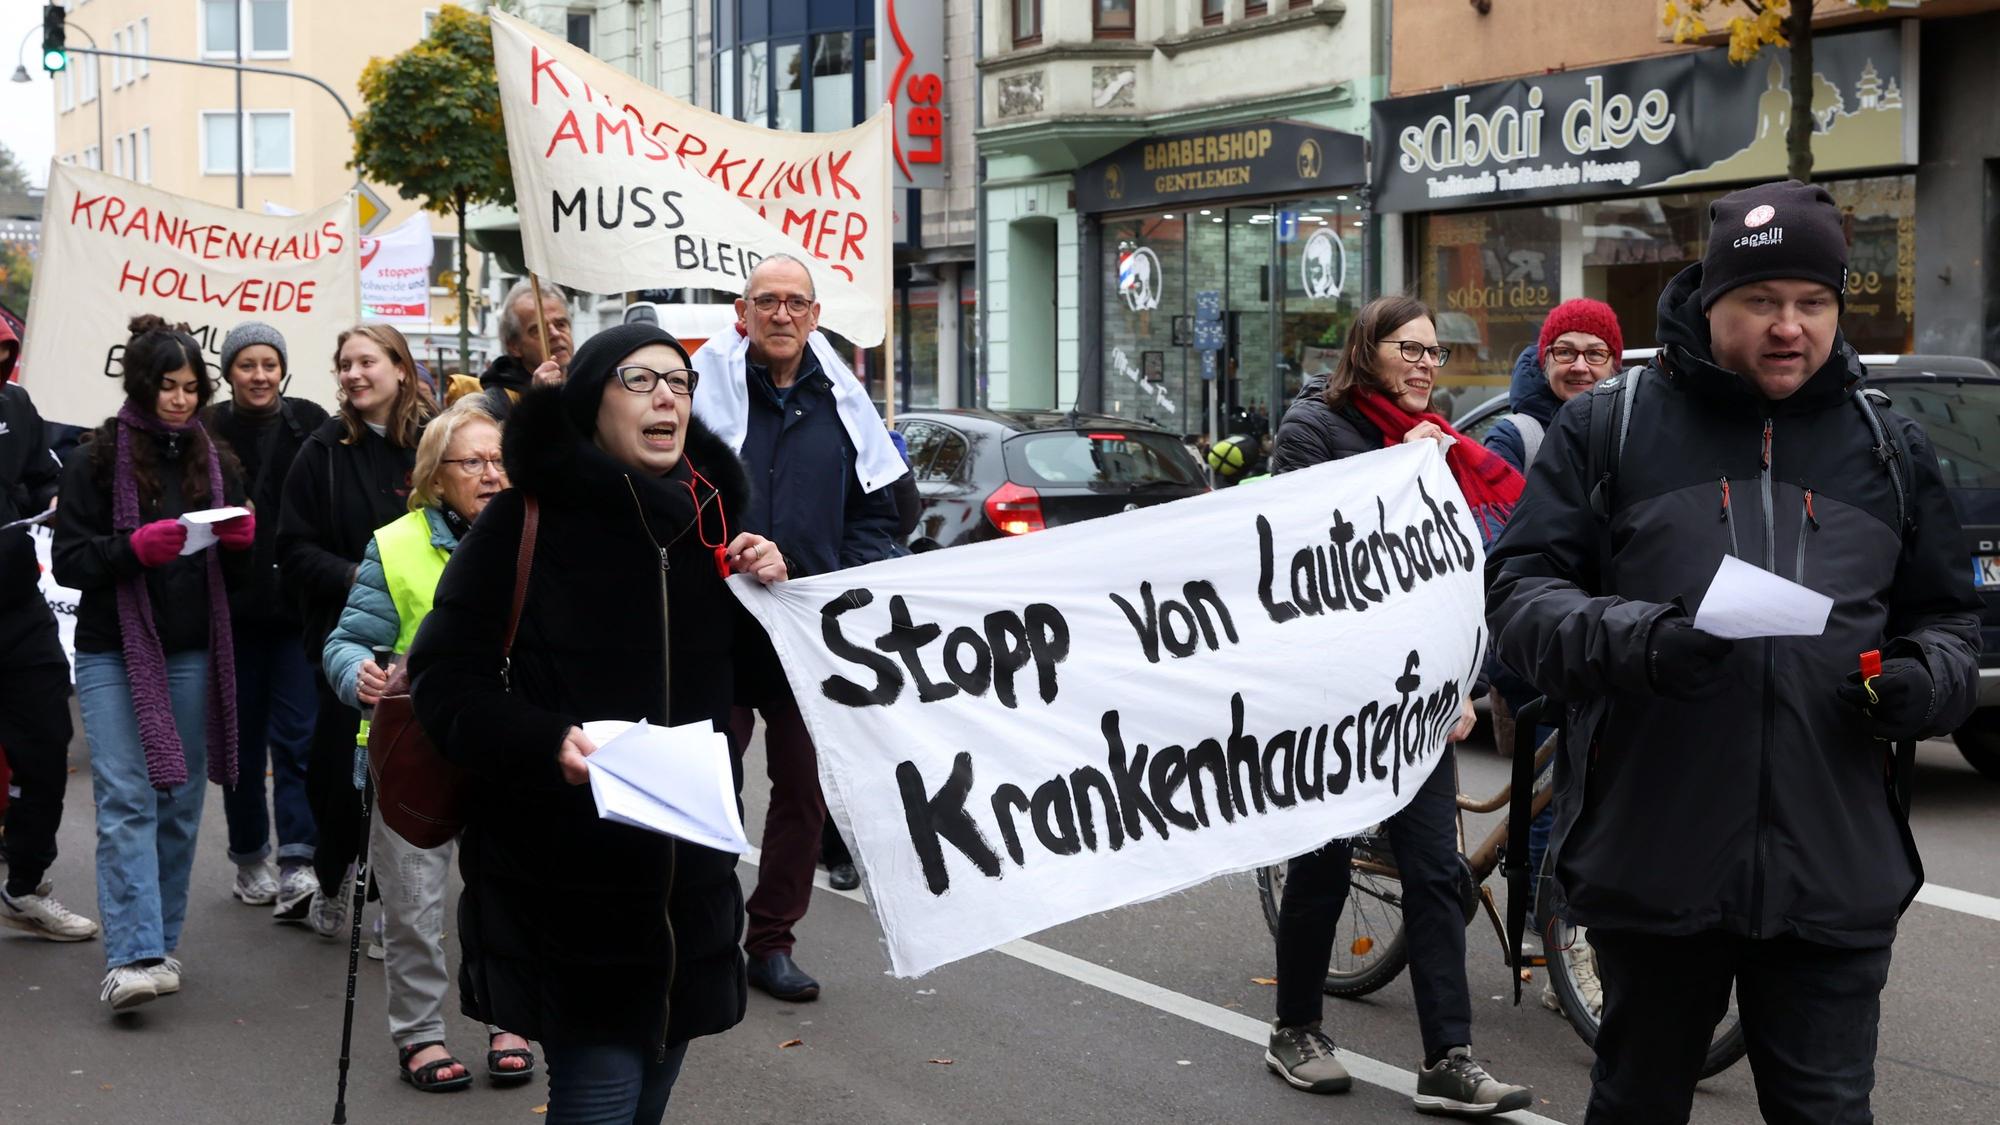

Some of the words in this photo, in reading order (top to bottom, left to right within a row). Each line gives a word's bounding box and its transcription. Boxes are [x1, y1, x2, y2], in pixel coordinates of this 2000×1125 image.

[907, 74, 943, 164] LBS
[1400, 85, 1544, 173] sabai
[1562, 75, 1676, 155] dee
[1144, 129, 1272, 171] BARBERSHOP
[1582, 160, 1640, 185] Massage
[1155, 166, 1250, 193] GENTLEMEN
[71, 191, 343, 261] KRANKENHAUS
[552, 186, 685, 232] MUSS
[1733, 228, 1783, 249] capelli
[119, 260, 316, 312] HOLWEIDE
[1510, 279, 1549, 307] dee
[820, 588, 1070, 708] Stopp
